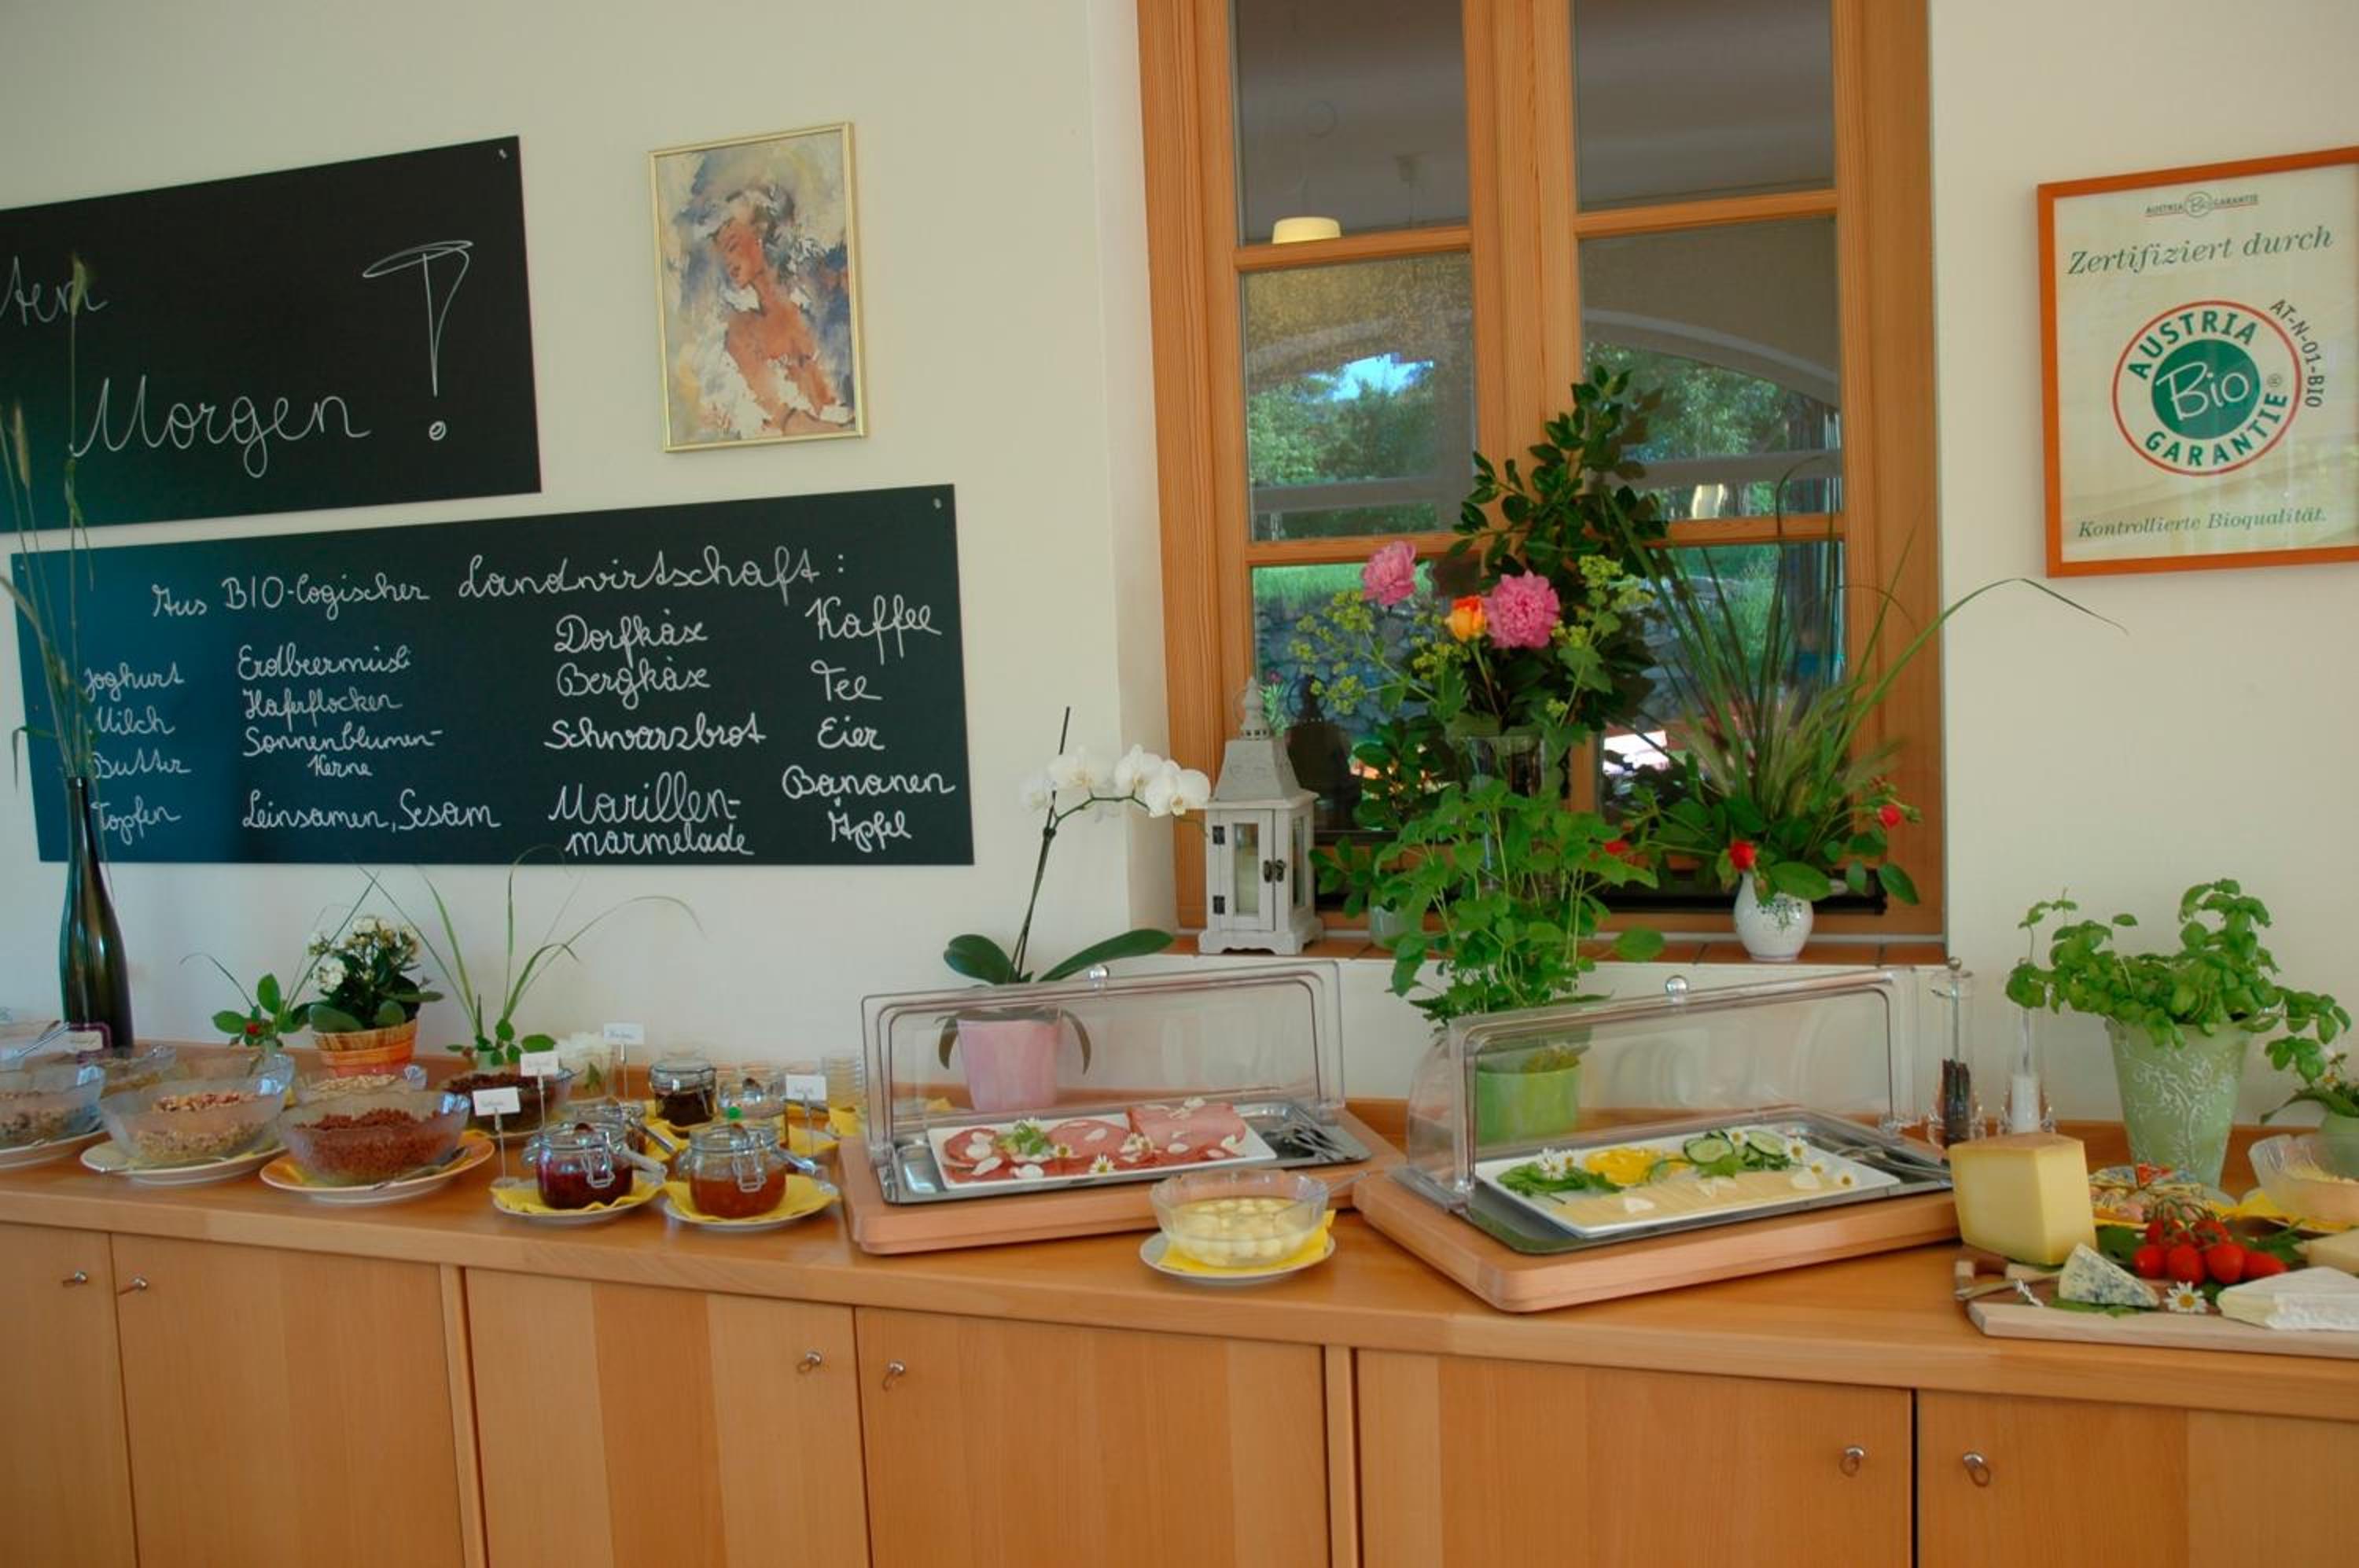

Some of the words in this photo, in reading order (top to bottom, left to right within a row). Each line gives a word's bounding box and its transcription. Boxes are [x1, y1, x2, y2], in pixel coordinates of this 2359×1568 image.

[2068, 236, 2233, 274] Zertifiziert
[2243, 225, 2334, 257] durch
[2127, 310, 2258, 381] AUSTRIA
[2269, 299, 2325, 408] AT-N-01-BIO
[2155, 361, 2250, 421] Bio
[69, 374, 370, 477] Morgen
[2145, 393, 2288, 468] GARANTIE
[2078, 519, 2200, 539] Kontrollierte
[151, 583, 207, 618] Aus
[554, 609, 708, 667] Dorfkäse
[804, 594, 943, 664] Kaffee
[557, 656, 711, 709] Bergkäse
[810, 660, 882, 701] Tee
[242, 687, 403, 731] Haferflocken
[544, 712, 767, 752] Schwarzbrot
[816, 715, 885, 750] Eier
[88, 749, 192, 779] Butter
[242, 727, 443, 757] Sonnenblumen-
[548, 771, 741, 824] Marillen-
[782, 765, 955, 798] Bananen
[90, 795, 182, 846] Topfen
[397, 788, 502, 830] Sesam
